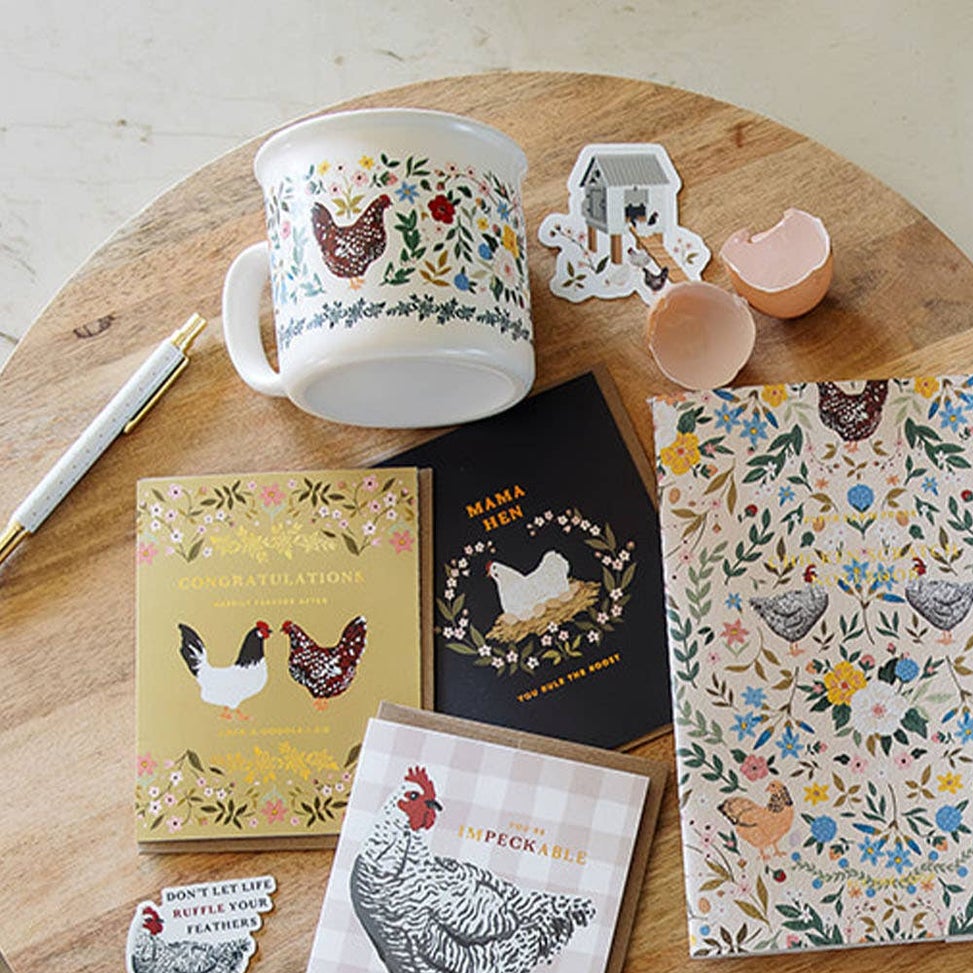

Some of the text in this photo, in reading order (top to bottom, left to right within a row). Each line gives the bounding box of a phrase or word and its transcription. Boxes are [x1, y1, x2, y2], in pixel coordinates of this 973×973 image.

[466, 485, 525, 518] MAMA
[483, 504, 524, 532] HEN
[768, 542, 961, 571] CHICKEN SCRATCH
[178, 571, 365, 590] CONGRATULATIONS
[517, 653, 620, 702] YOU RULE THE ROOST
[458, 824, 588, 865] IMPECKABLE
[166, 880, 272, 902] DON'T LET LIFE
[173, 898, 269, 918] RUFFLE YOUR
[187, 917, 258, 934] FEATHERS
